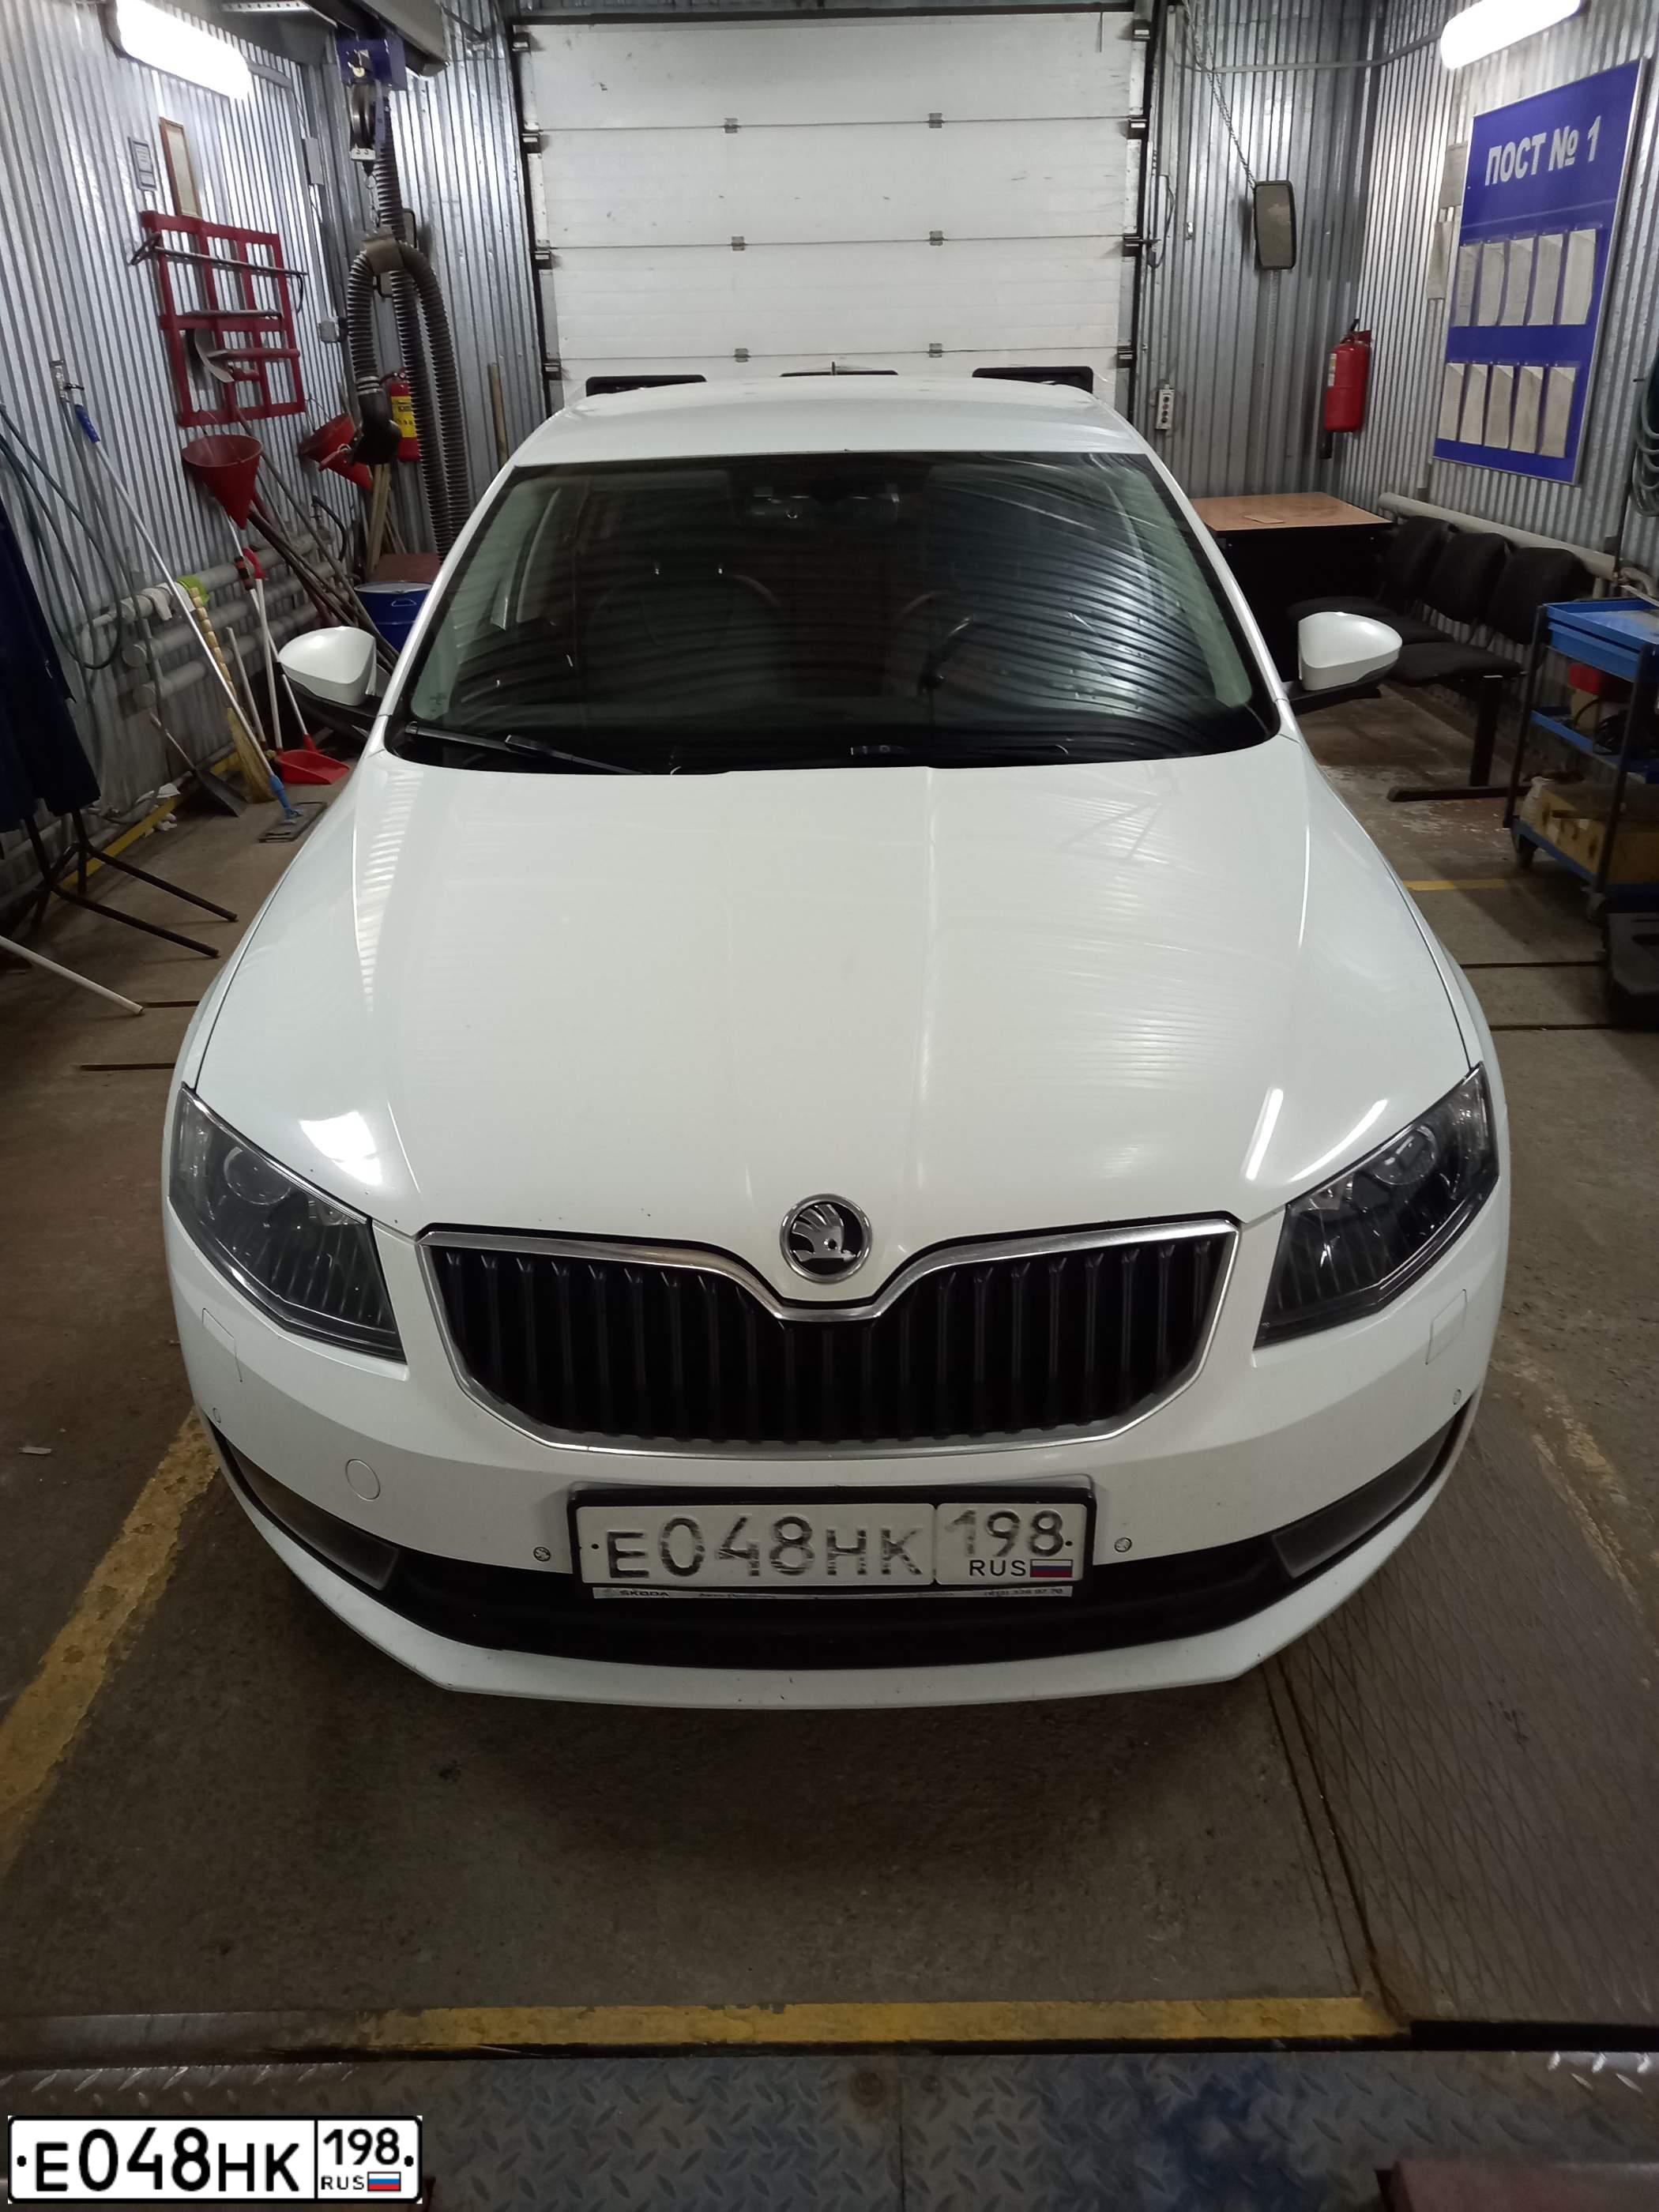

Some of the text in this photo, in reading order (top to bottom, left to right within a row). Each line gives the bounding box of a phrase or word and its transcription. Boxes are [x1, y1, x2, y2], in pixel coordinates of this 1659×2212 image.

[1484, 115, 1601, 186] ПОСТ № 1
[946, 1509, 1064, 1557] 198
[969, 1559, 1026, 1577] RUS
